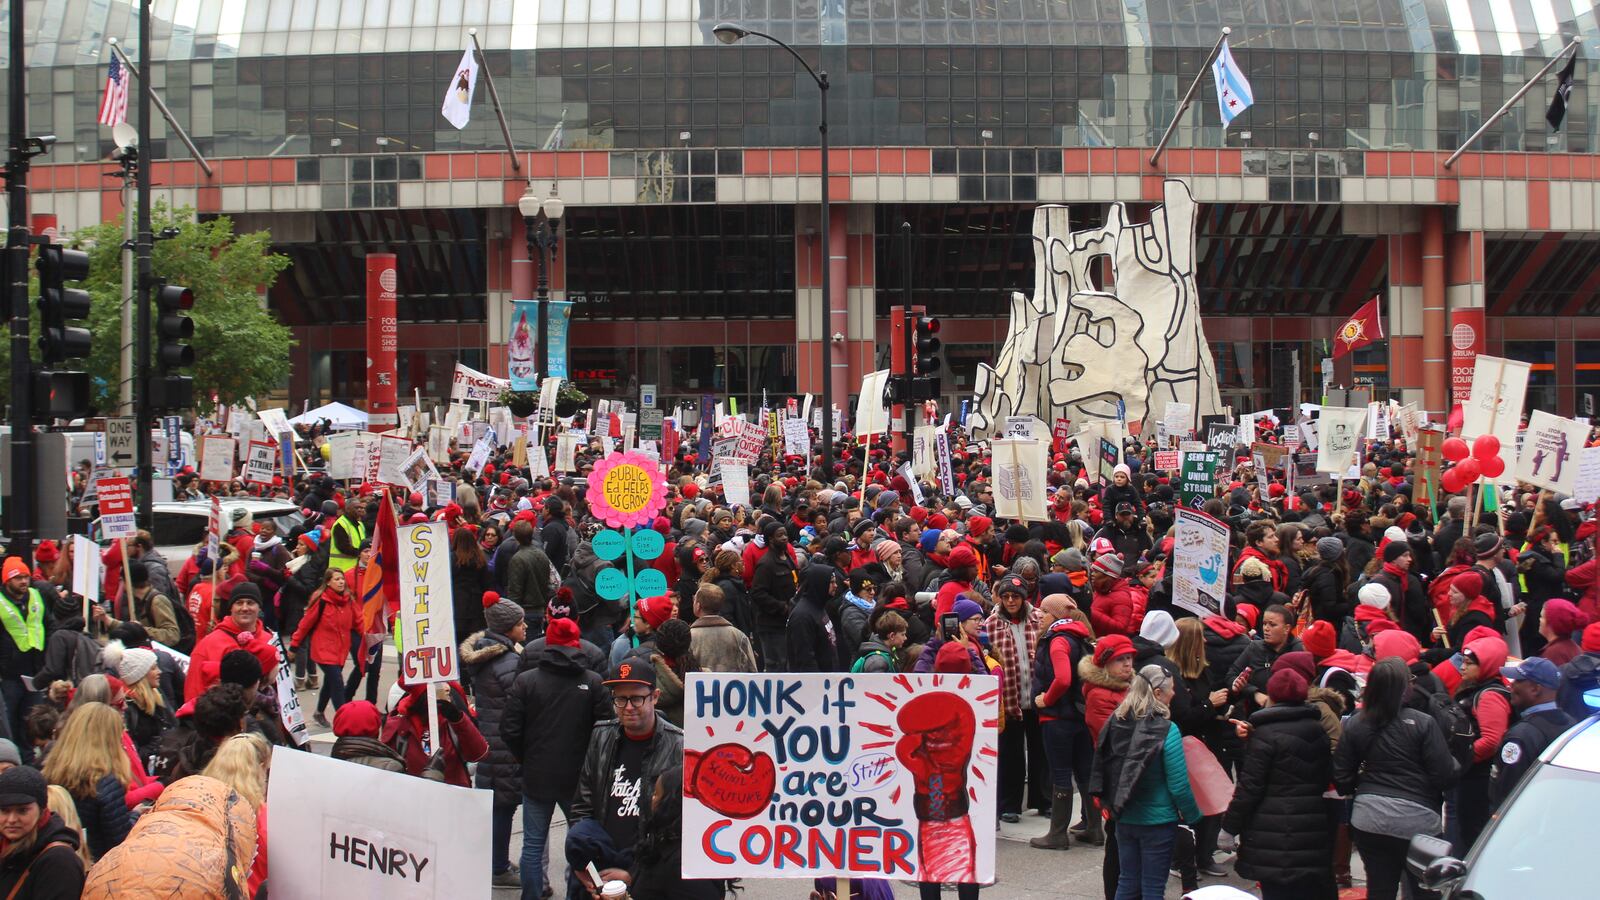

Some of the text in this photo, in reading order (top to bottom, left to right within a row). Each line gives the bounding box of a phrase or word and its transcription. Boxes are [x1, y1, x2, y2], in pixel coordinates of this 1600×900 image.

[110, 422, 132, 434] ONE
[110, 436, 131, 448] WAY
[258, 450, 268, 459] ON
[249, 459, 273, 471] STRIKE
[1197, 462, 1204, 471] IS
[610, 466, 647, 481] PUBLIC
[1188, 472, 1209, 481] UNION
[606, 481, 649, 494] Ed HELPS
[1184, 483, 1212, 493] STRONG
[610, 494, 648, 509] US GROW
[405, 646, 451, 679] CTU
[695, 677, 856, 723] HONK if
[761, 716, 851, 764] YOU
[782, 770, 848, 797] are
[768, 792, 903, 827] in OUR
[701, 819, 916, 875] CORNER
[330, 832, 428, 883] HENRY
